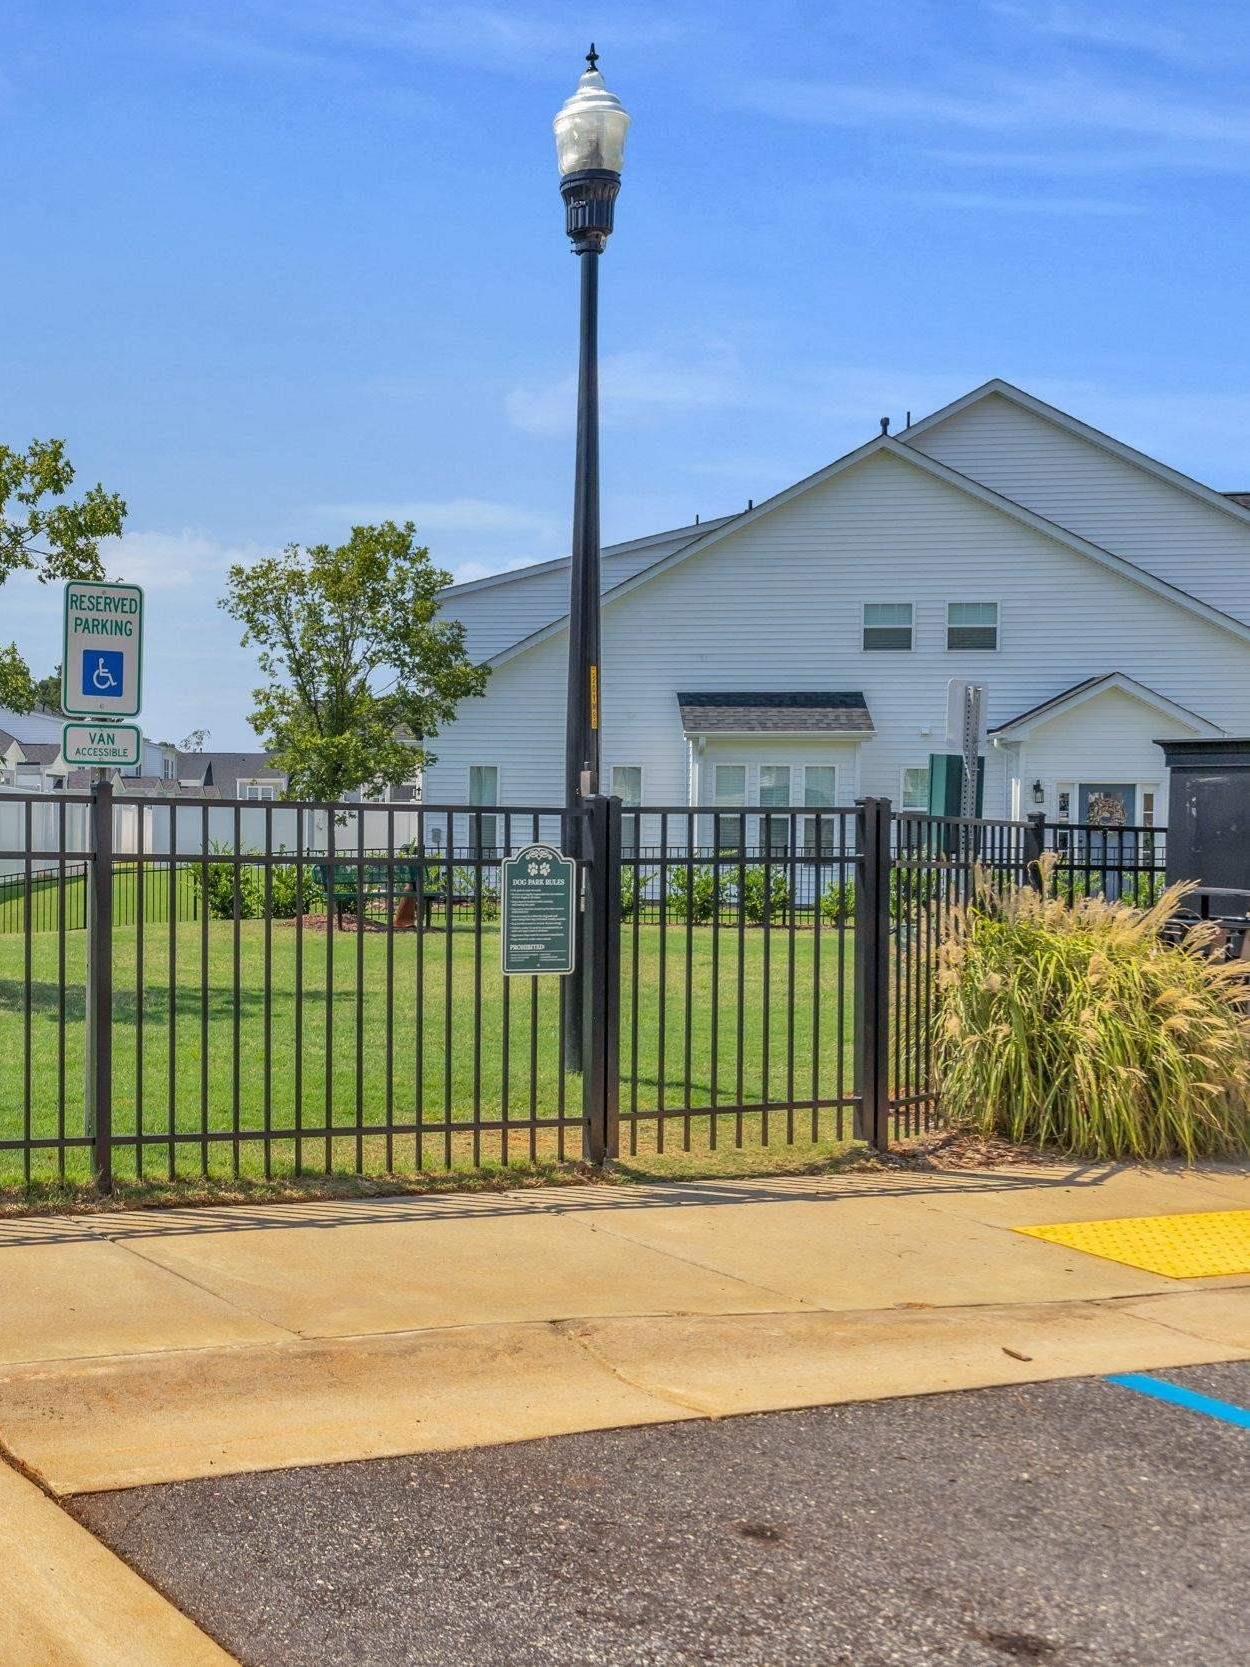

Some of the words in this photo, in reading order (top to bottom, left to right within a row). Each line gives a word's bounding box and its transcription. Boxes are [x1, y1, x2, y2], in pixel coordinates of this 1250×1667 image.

[70, 593, 138, 614] RESERVED
[74, 617, 133, 637] PARKING
[88, 732, 115, 746] VAN
[75, 747, 129, 758] ACCESSIBLE
[512, 878, 527, 886] DOG
[527, 878, 545, 886] PARK
[545, 878, 565, 886] RULES
